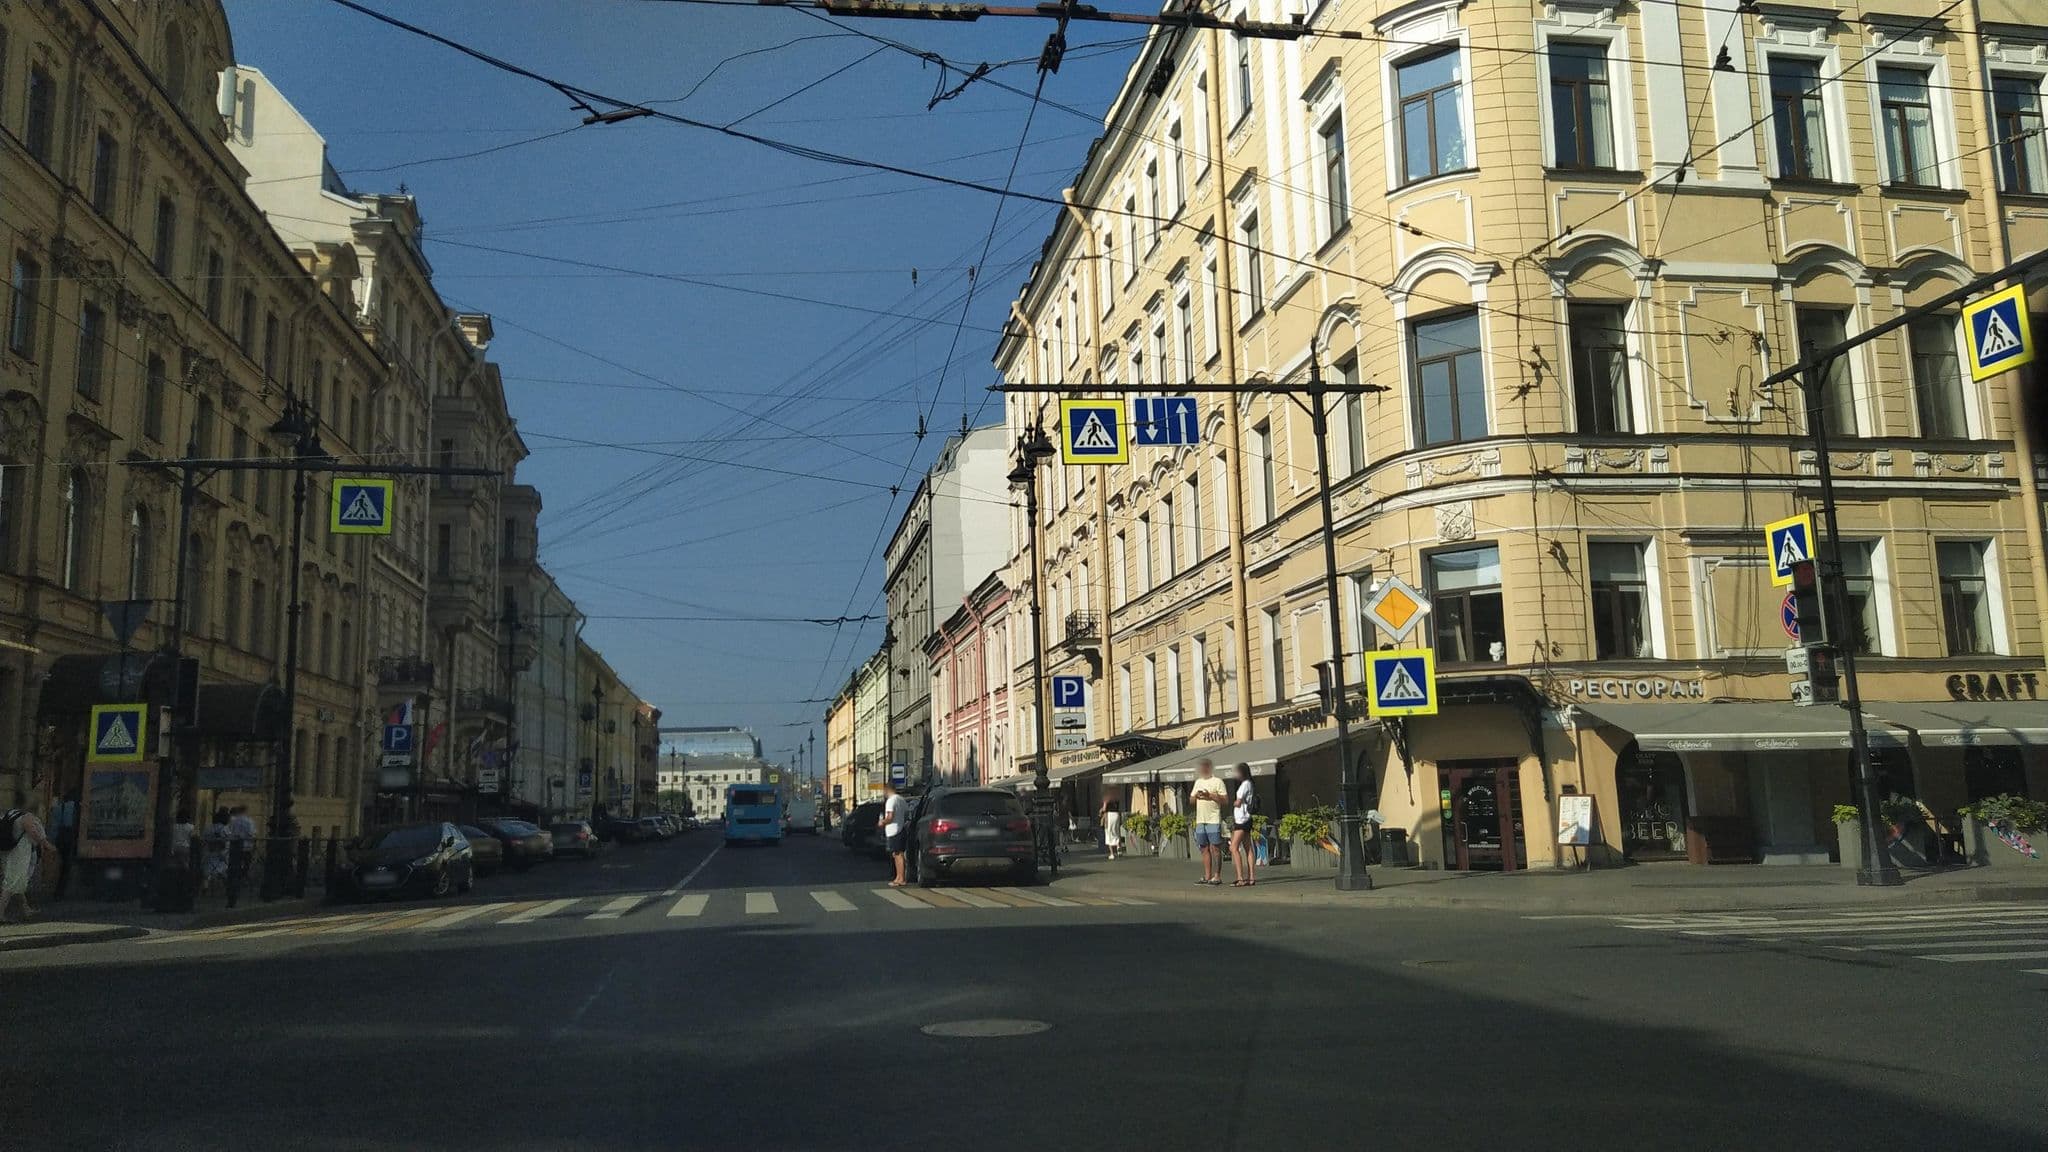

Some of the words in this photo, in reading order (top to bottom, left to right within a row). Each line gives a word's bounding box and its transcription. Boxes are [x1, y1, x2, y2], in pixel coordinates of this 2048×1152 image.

[1061, 679, 1079, 705] P
[1569, 679, 1704, 698] РЕСТОРАН
[1946, 674, 2038, 700] CRAFT
[391, 726, 408, 748] P
[1467, 785, 1492, 796] WELCOME
